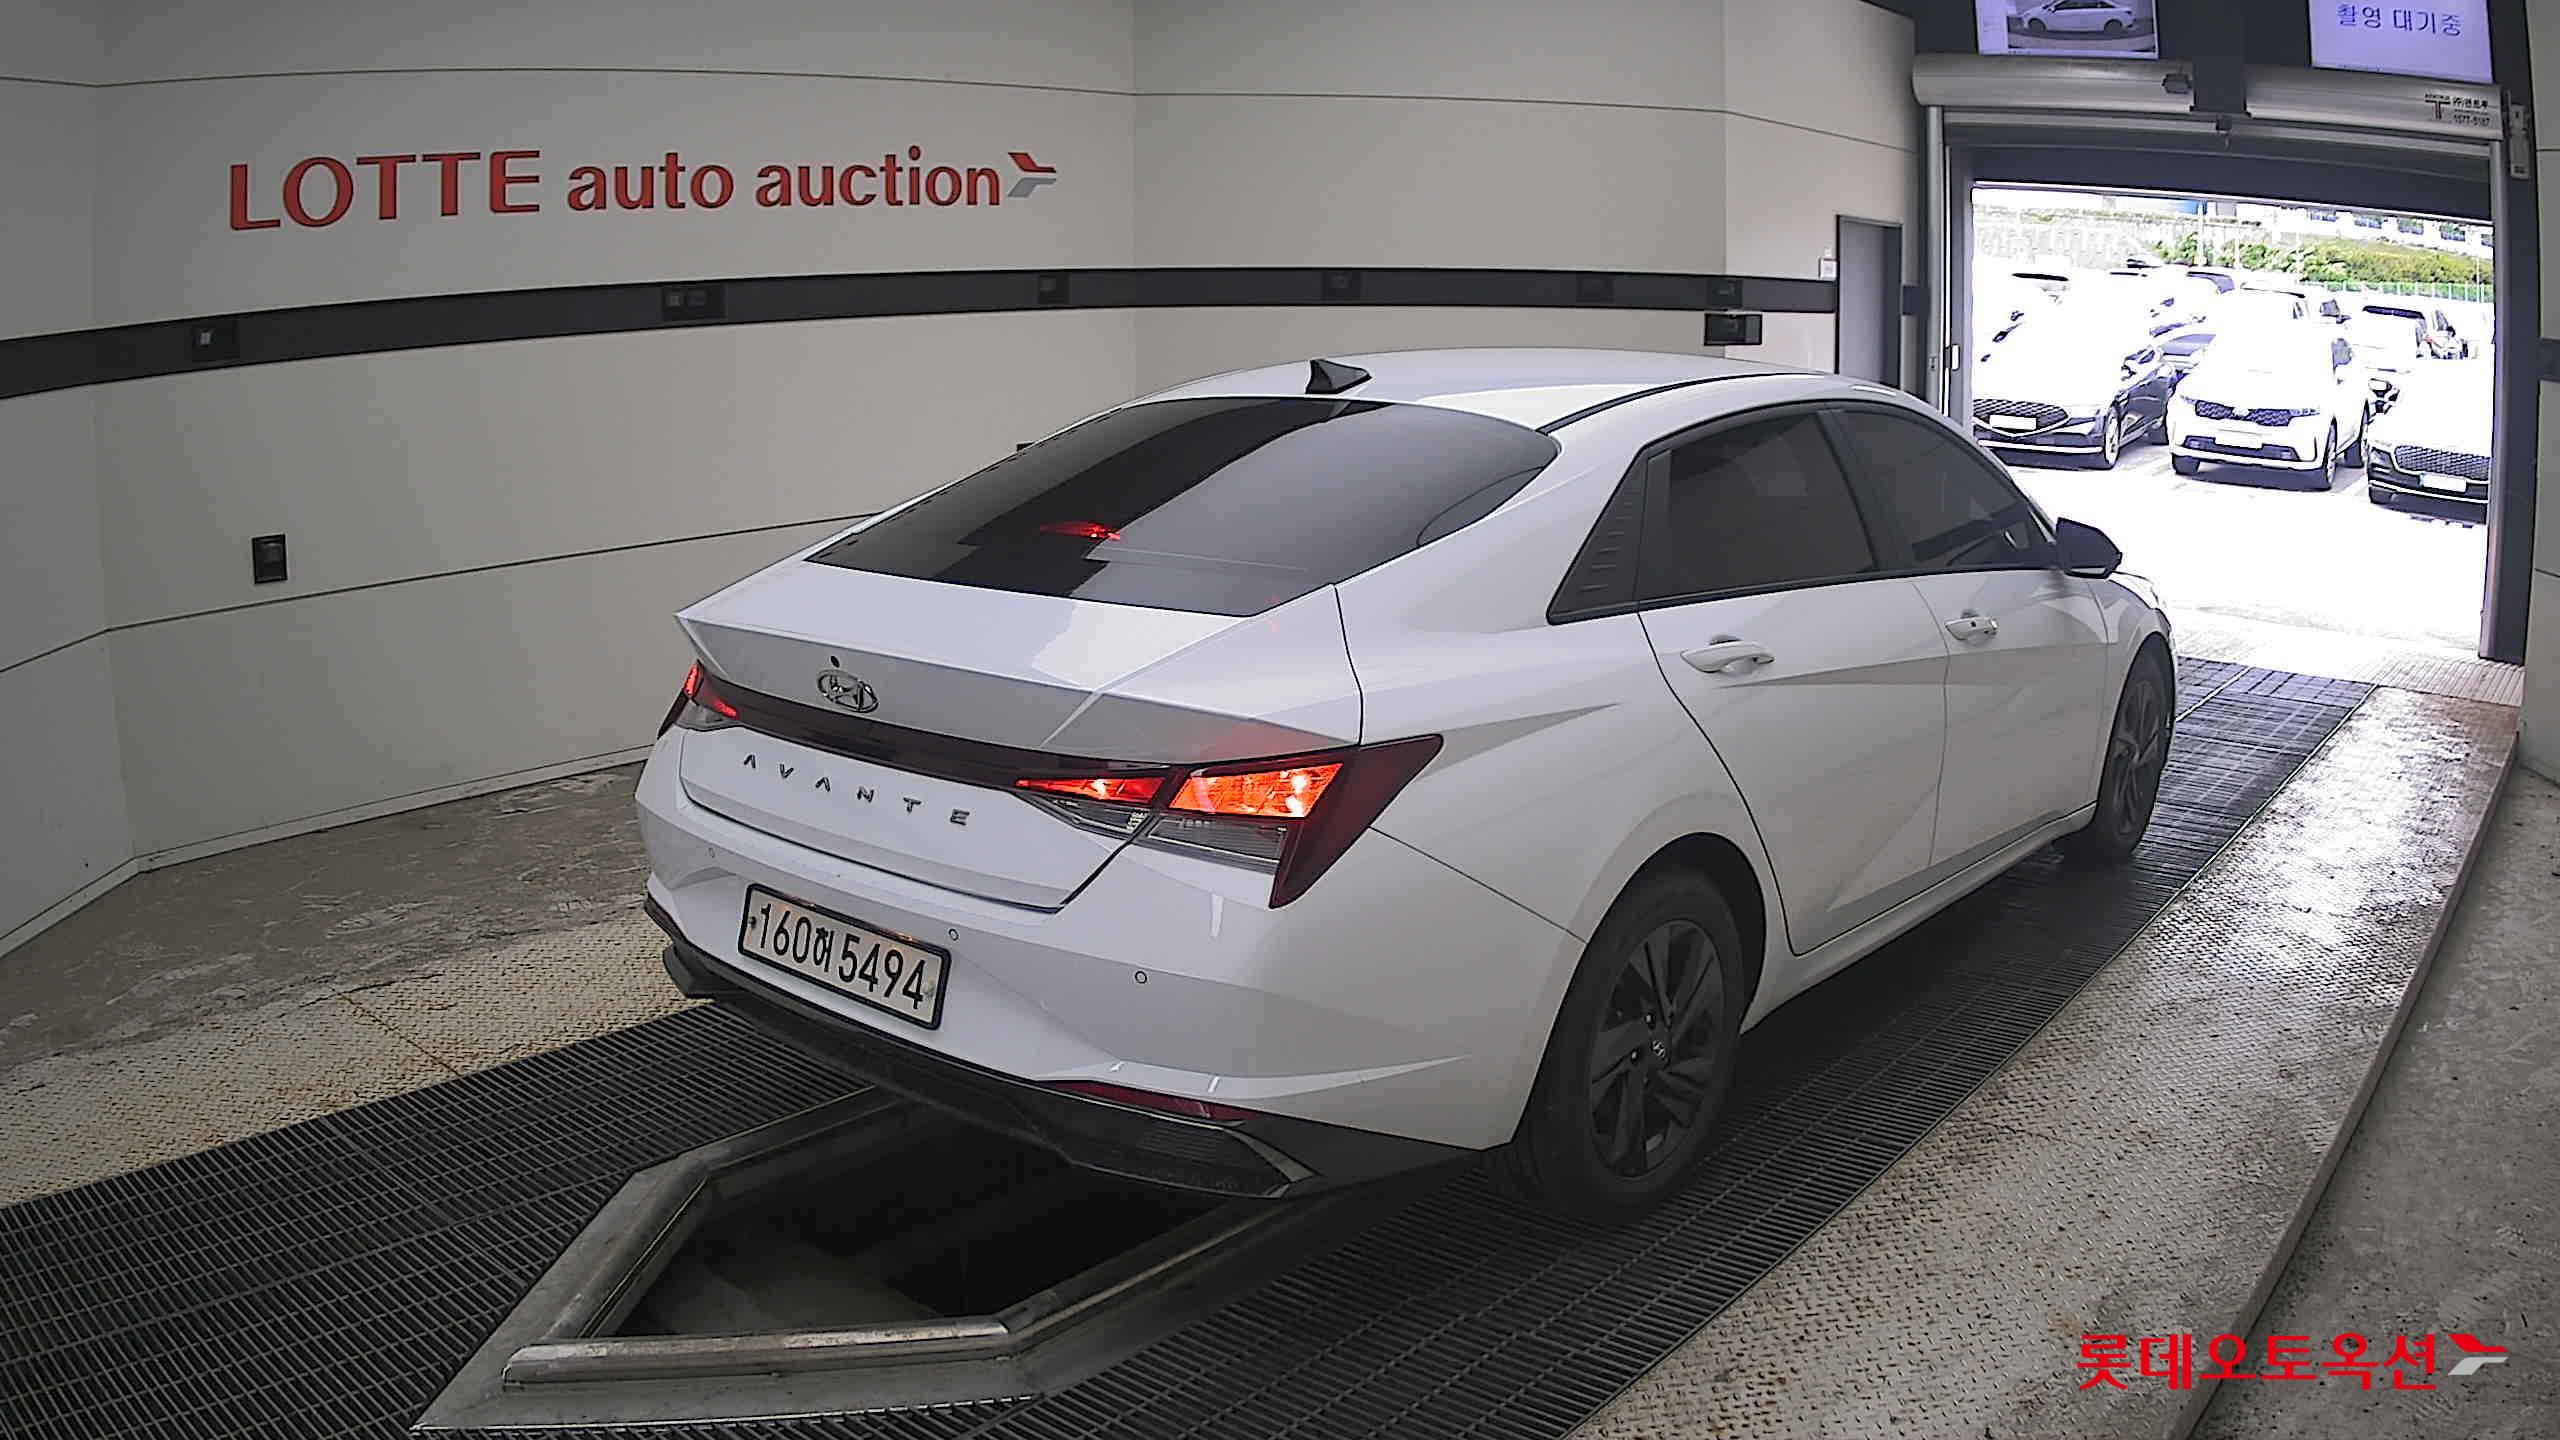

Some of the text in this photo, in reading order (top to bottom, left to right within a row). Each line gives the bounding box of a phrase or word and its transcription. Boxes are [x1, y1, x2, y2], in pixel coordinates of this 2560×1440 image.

[2338, 4, 2462, 37] 촬영 대기중
[230, 145, 1002, 231] LOTTE auto auction
[743, 754, 971, 826] AVANTE
